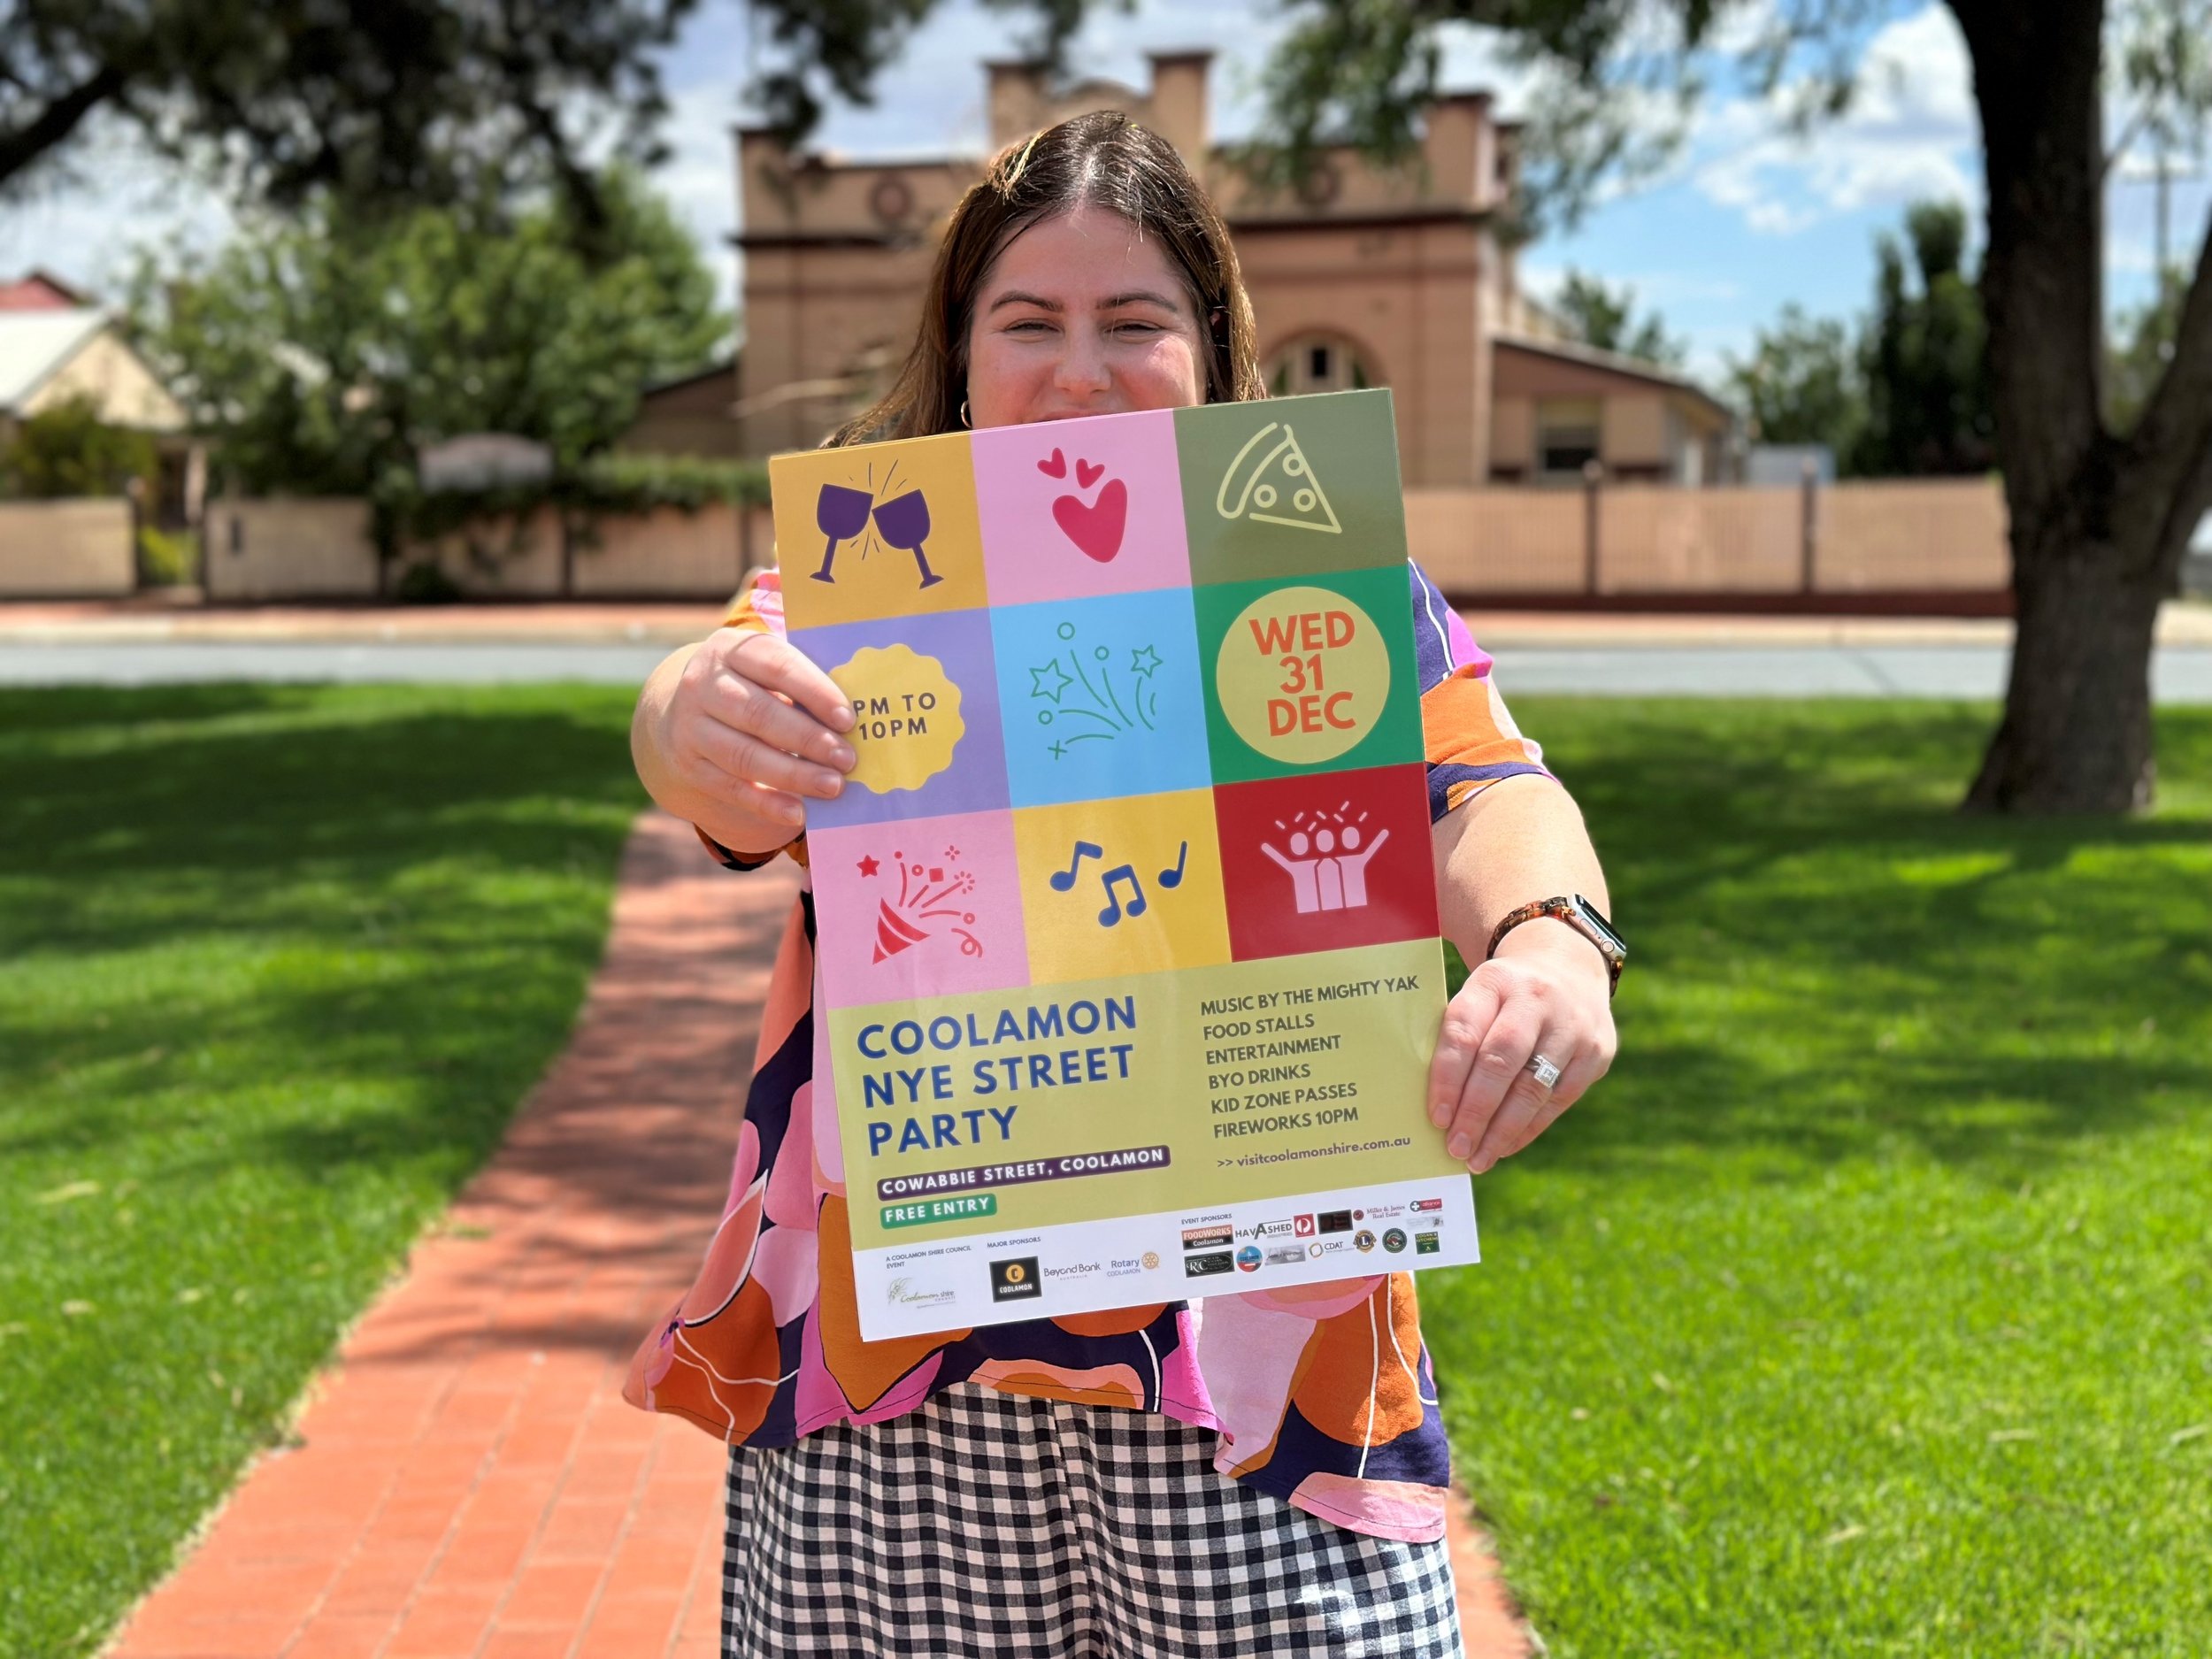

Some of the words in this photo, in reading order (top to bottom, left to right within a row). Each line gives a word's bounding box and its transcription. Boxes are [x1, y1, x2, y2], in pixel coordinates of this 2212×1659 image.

[1248, 611, 1356, 656] WED
[1279, 653, 1325, 694] 31
[852, 696, 890, 718] PM
[902, 692, 936, 712] TO
[1267, 691, 1356, 737] DEC
[858, 716, 927, 741] 10PM
[1201, 995, 1254, 1016] MUSIC
[1258, 993, 1279, 1009] BY
[1283, 988, 1313, 1005] THE
[1317, 980, 1380, 1002] MIGHTY
[1384, 975, 1419, 992] YAK
[857, 995, 1136, 1059] COOLAMON
[1203, 1021, 1251, 1041] FOOD
[1256, 1014, 1315, 1034] STALLS
[1206, 1034, 1341, 1064] ENTERTAINMENT
[863, 1064, 954, 1108] NYE
[972, 1044, 1133, 1094] STREET
[1209, 1071, 1244, 1089] BYO
[1248, 1064, 1311, 1084] DRINKS
[1211, 1097, 1239, 1114] KID
[1244, 1090, 1290, 1110] ZONE
[1294, 1082, 1357, 1102] PASSES
[868, 1105, 1018, 1156] PARTY
[1213, 1113, 1311, 1139] FIREWORKS
[1316, 1107, 1358, 1125] 10PM
[1237, 1136, 1411, 1167] visitcoolamonshire.com.au
[881, 1170, 976, 1194] COWABBIE
[984, 1161, 1055, 1182] STREET,
[1060, 1148, 1164, 1172] COOLAMON
[885, 1208, 926, 1223] FREE
[933, 1197, 991, 1217] ENTRY
[1201, 1213, 1232, 1223] SPONSORS
[1183, 1227, 1231, 1240] FOODWORKS
[1325, 1241, 1344, 1250] CDAT
[892, 1251, 926, 1261] COOLAMON
[1110, 1258, 1141, 1269] Rotary
[1044, 1264, 1078, 1277] Beyond
[1079, 1262, 1102, 1272] Bank
[1107, 1268, 1141, 1278] COOLAMON
[901, 1291, 939, 1302] Coolamon
[999, 1283, 1033, 1294] COOLAMON
